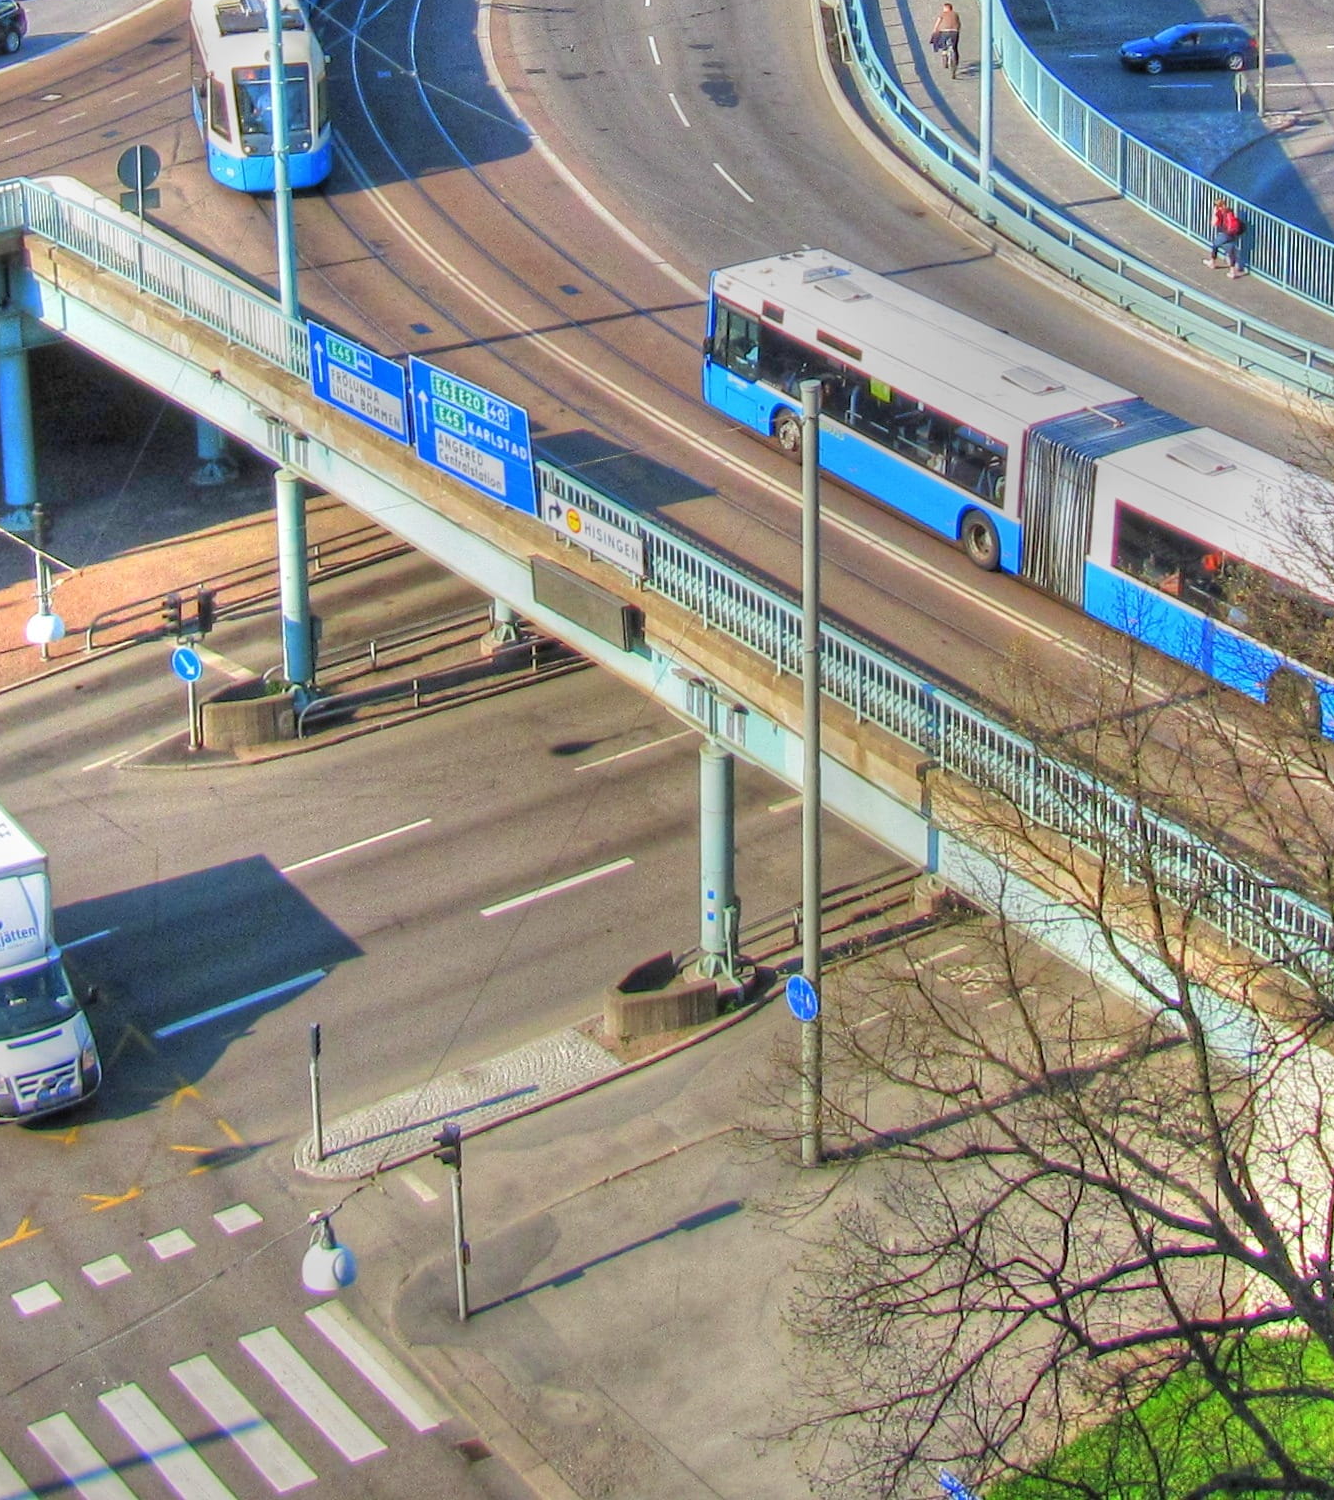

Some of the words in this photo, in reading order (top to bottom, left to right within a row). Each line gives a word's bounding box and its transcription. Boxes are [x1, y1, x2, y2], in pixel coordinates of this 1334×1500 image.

[331, 340, 352, 362] E45
[331, 368, 380, 404] FRÖLUNDA
[433, 375, 451, 396] E6
[458, 388, 482, 410] E20
[488, 403, 505, 423] 40
[332, 386, 356, 405] LILLA
[360, 400, 402, 430] BOMMEN
[438, 430, 484, 466] ANGERED
[439, 407, 461, 427] E45
[467, 422, 528, 460] KARLSTAD
[439, 448, 504, 490] Centralstation
[584, 522, 640, 561] HISINGEN
